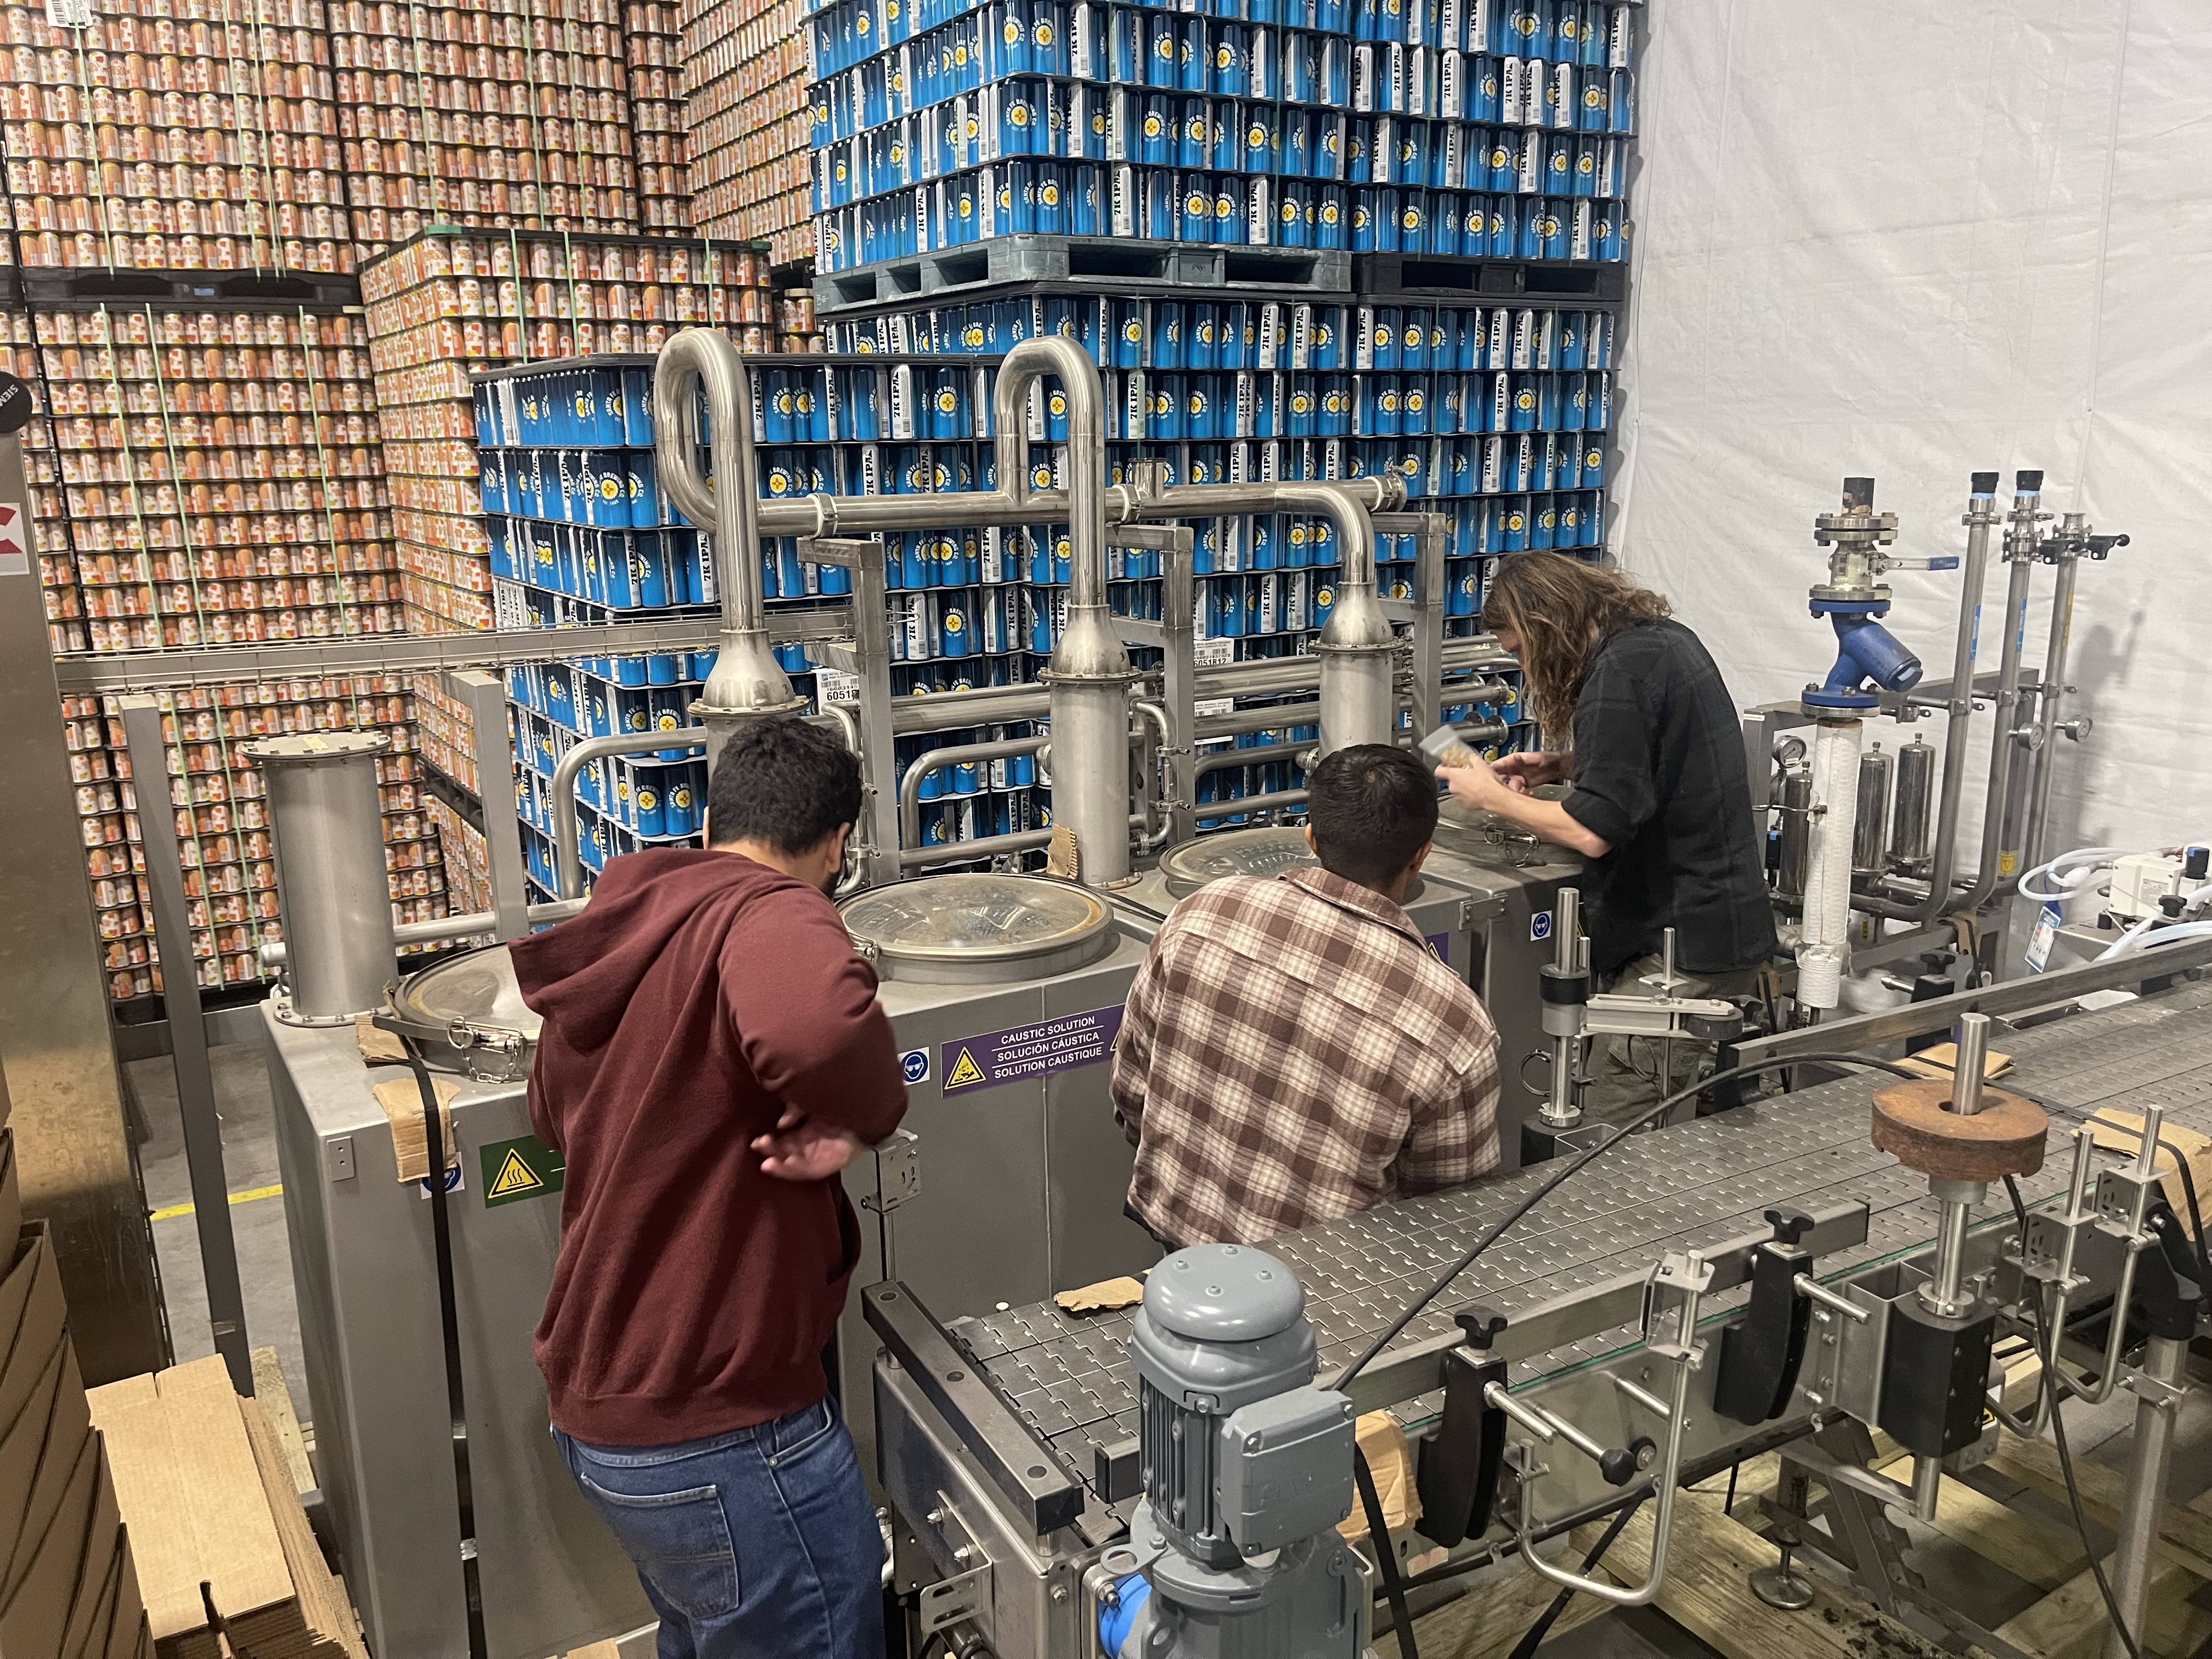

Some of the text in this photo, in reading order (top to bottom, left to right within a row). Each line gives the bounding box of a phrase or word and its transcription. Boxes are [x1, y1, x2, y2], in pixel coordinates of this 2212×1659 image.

[1445, 13, 1451, 29] 7K
[1471, 18, 1477, 32] 7K
[1071, 40, 1076, 57] 7K
[1612, 36, 1618, 50] 7K
[1394, 76, 1400, 91] 7K
[1444, 83, 1451, 98] 7K
[1505, 89, 1513, 104] 7K
[1526, 93, 1532, 107] 7K
[1448, 154, 1453, 168] 7K
[1521, 161, 1527, 175] 7K
[1114, 199, 1120, 215] 7K
[1251, 209, 1257, 224] 7K
[919, 218, 924, 233] 7K
[1263, 334, 1269, 349] 7K
[1296, 335, 1302, 349] 7K
[1359, 336, 1365, 350] 7K
[1493, 338, 1499, 352] 7K
[1515, 339, 1522, 352] 7K
[756, 404, 762, 420] 7K
[830, 403, 835, 418] 7K
[893, 402, 900, 417] 7K
[1131, 404, 1137, 419] 7K
[1239, 404, 1244, 418] 7K
[1497, 402, 1503, 414] 7K
[1485, 463, 1491, 476] 7K
[1521, 461, 1526, 475] 7K
[867, 479, 873, 494] 7K
[923, 477, 929, 492] 7K
[564, 486, 570, 500] 7K
[701, 534, 711, 581] 7K IPA
[983, 549, 990, 563] 7K
[630, 568, 637, 585] 7K
[1263, 603, 1269, 616] 7K
[1009, 617, 1015, 630] 7K
[1059, 619, 1065, 632] 7K
[909, 627, 915, 640] 7K
[1001, 1016, 1094, 1044] CAUSTIC SOLUTION
[997, 1032, 1099, 1062] SOLUCIÓN CÁUSTICA
[995, 1047, 1102, 1079] SOLUTION CAUSTIQUE
